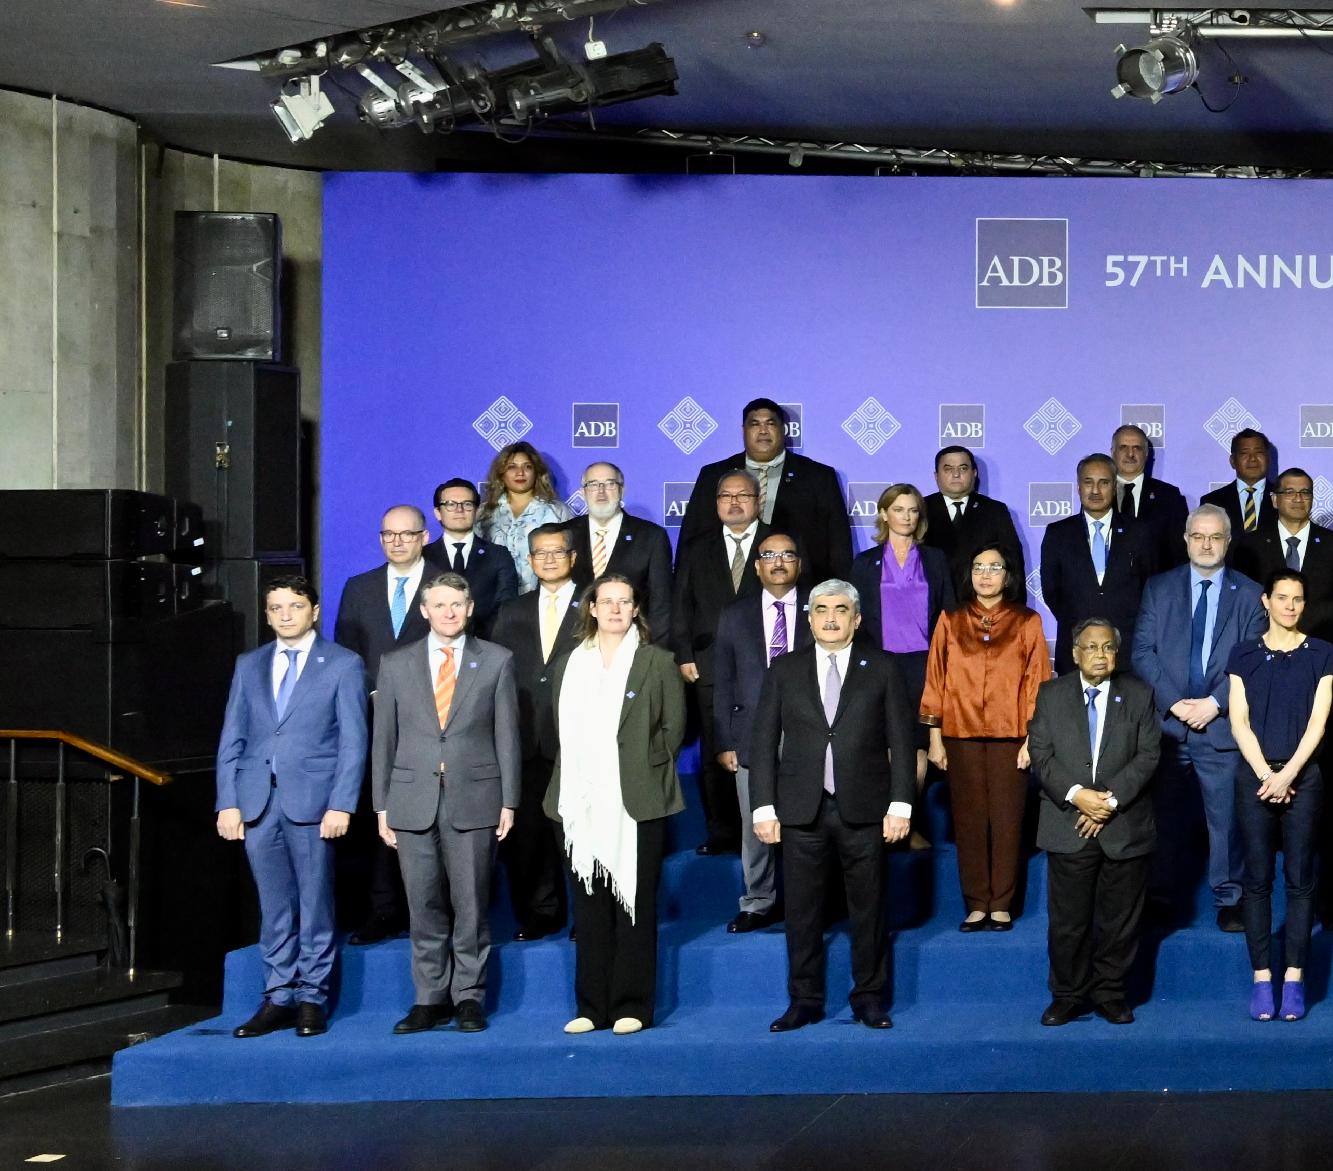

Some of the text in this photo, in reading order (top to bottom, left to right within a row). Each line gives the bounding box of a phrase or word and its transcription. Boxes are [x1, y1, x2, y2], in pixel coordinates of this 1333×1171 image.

[978, 256, 1063, 286] ADB
[1105, 254, 1188, 288] 57TH
[574, 421, 616, 437] ADB
[941, 421, 983, 437] ADB
[1129, 422, 1162, 437] DB
[849, 500, 878, 517] AD
[1030, 500, 1073, 517] ADB
